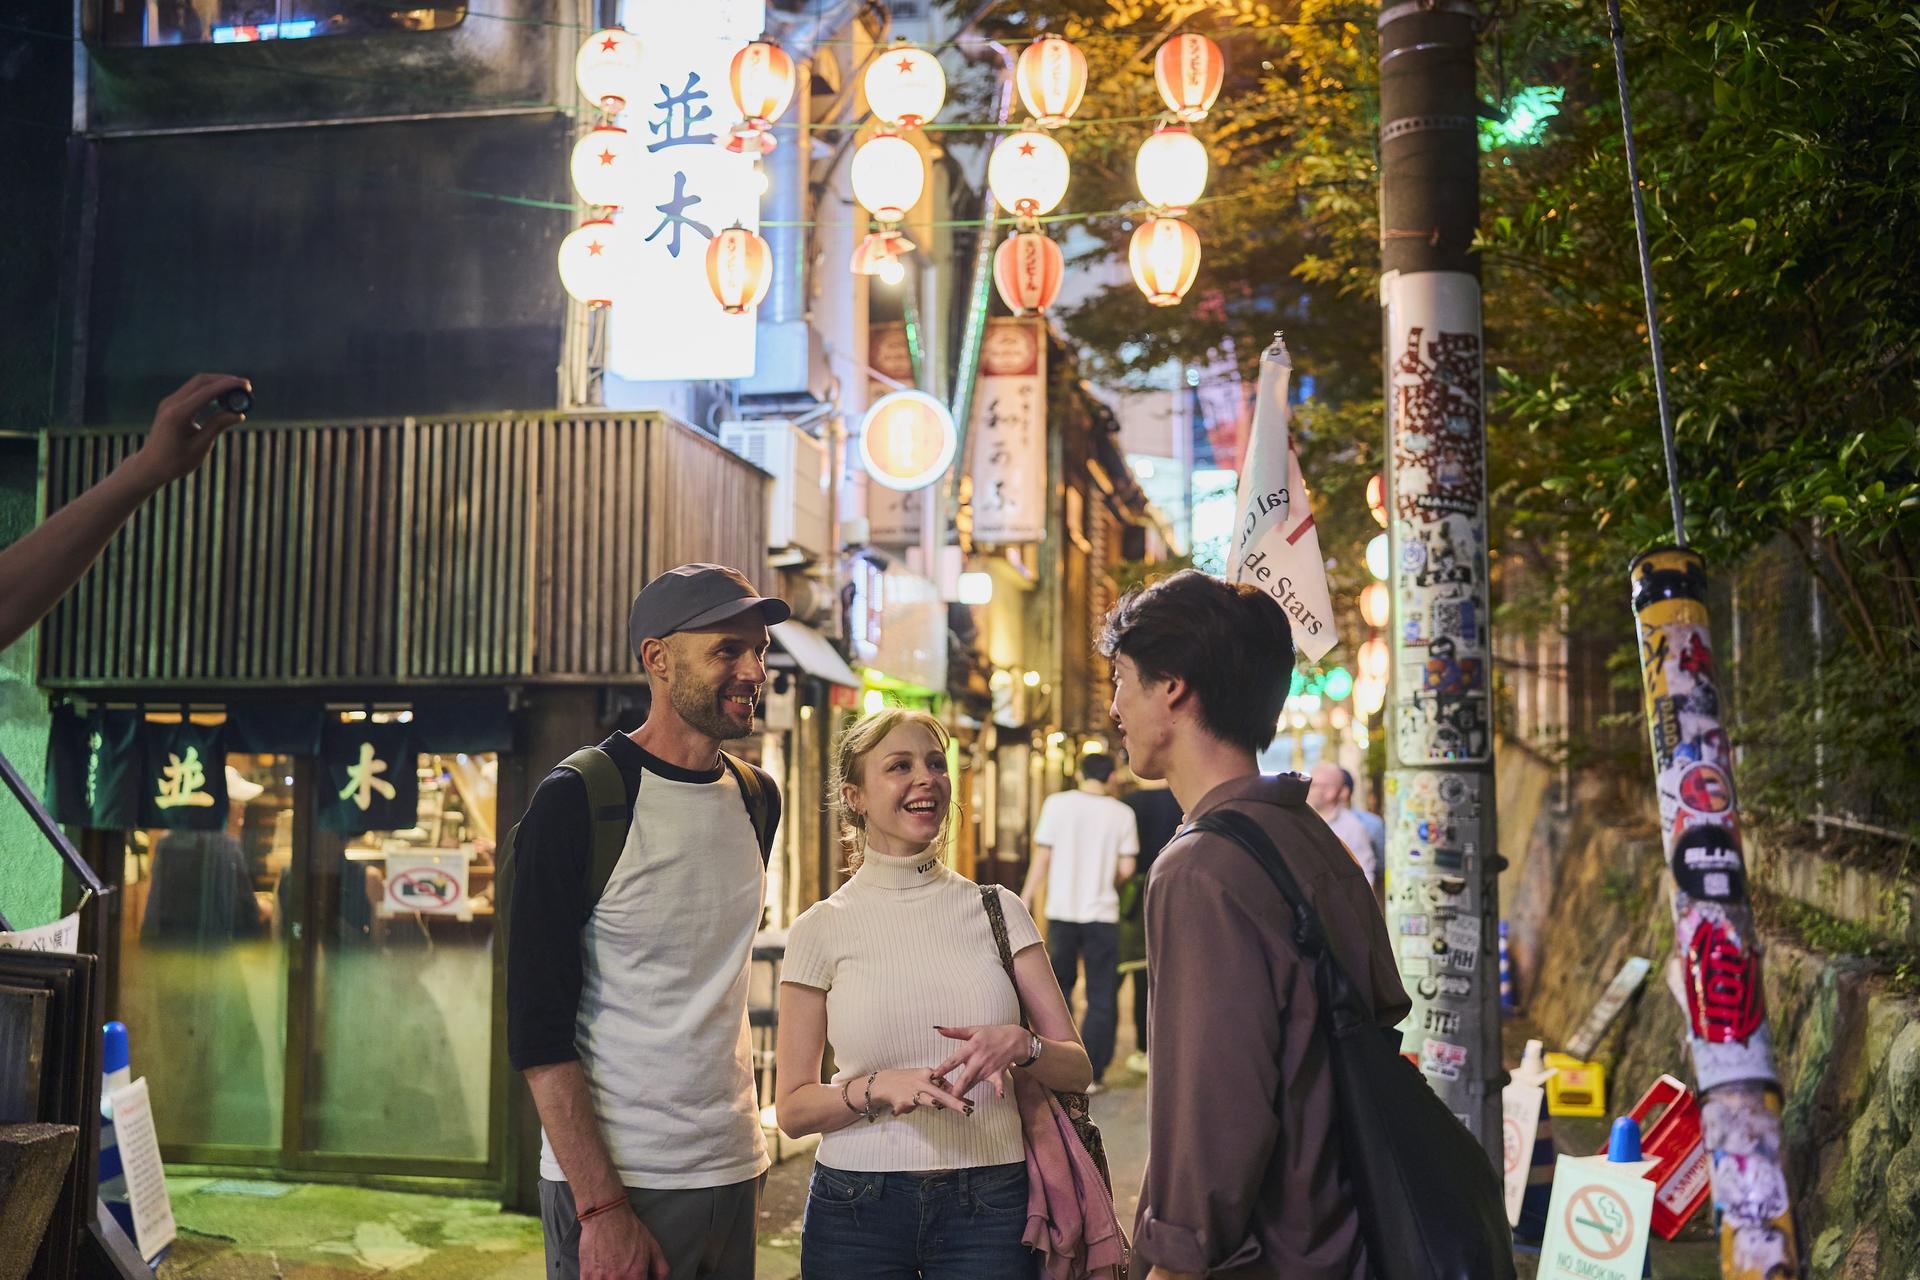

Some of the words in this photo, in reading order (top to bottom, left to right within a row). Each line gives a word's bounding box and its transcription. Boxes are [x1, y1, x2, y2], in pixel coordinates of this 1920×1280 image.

[645, 71, 718, 258] 並木
[1270, 577, 1323, 635] Stars
[1557, 1252, 1572, 1269] NO
